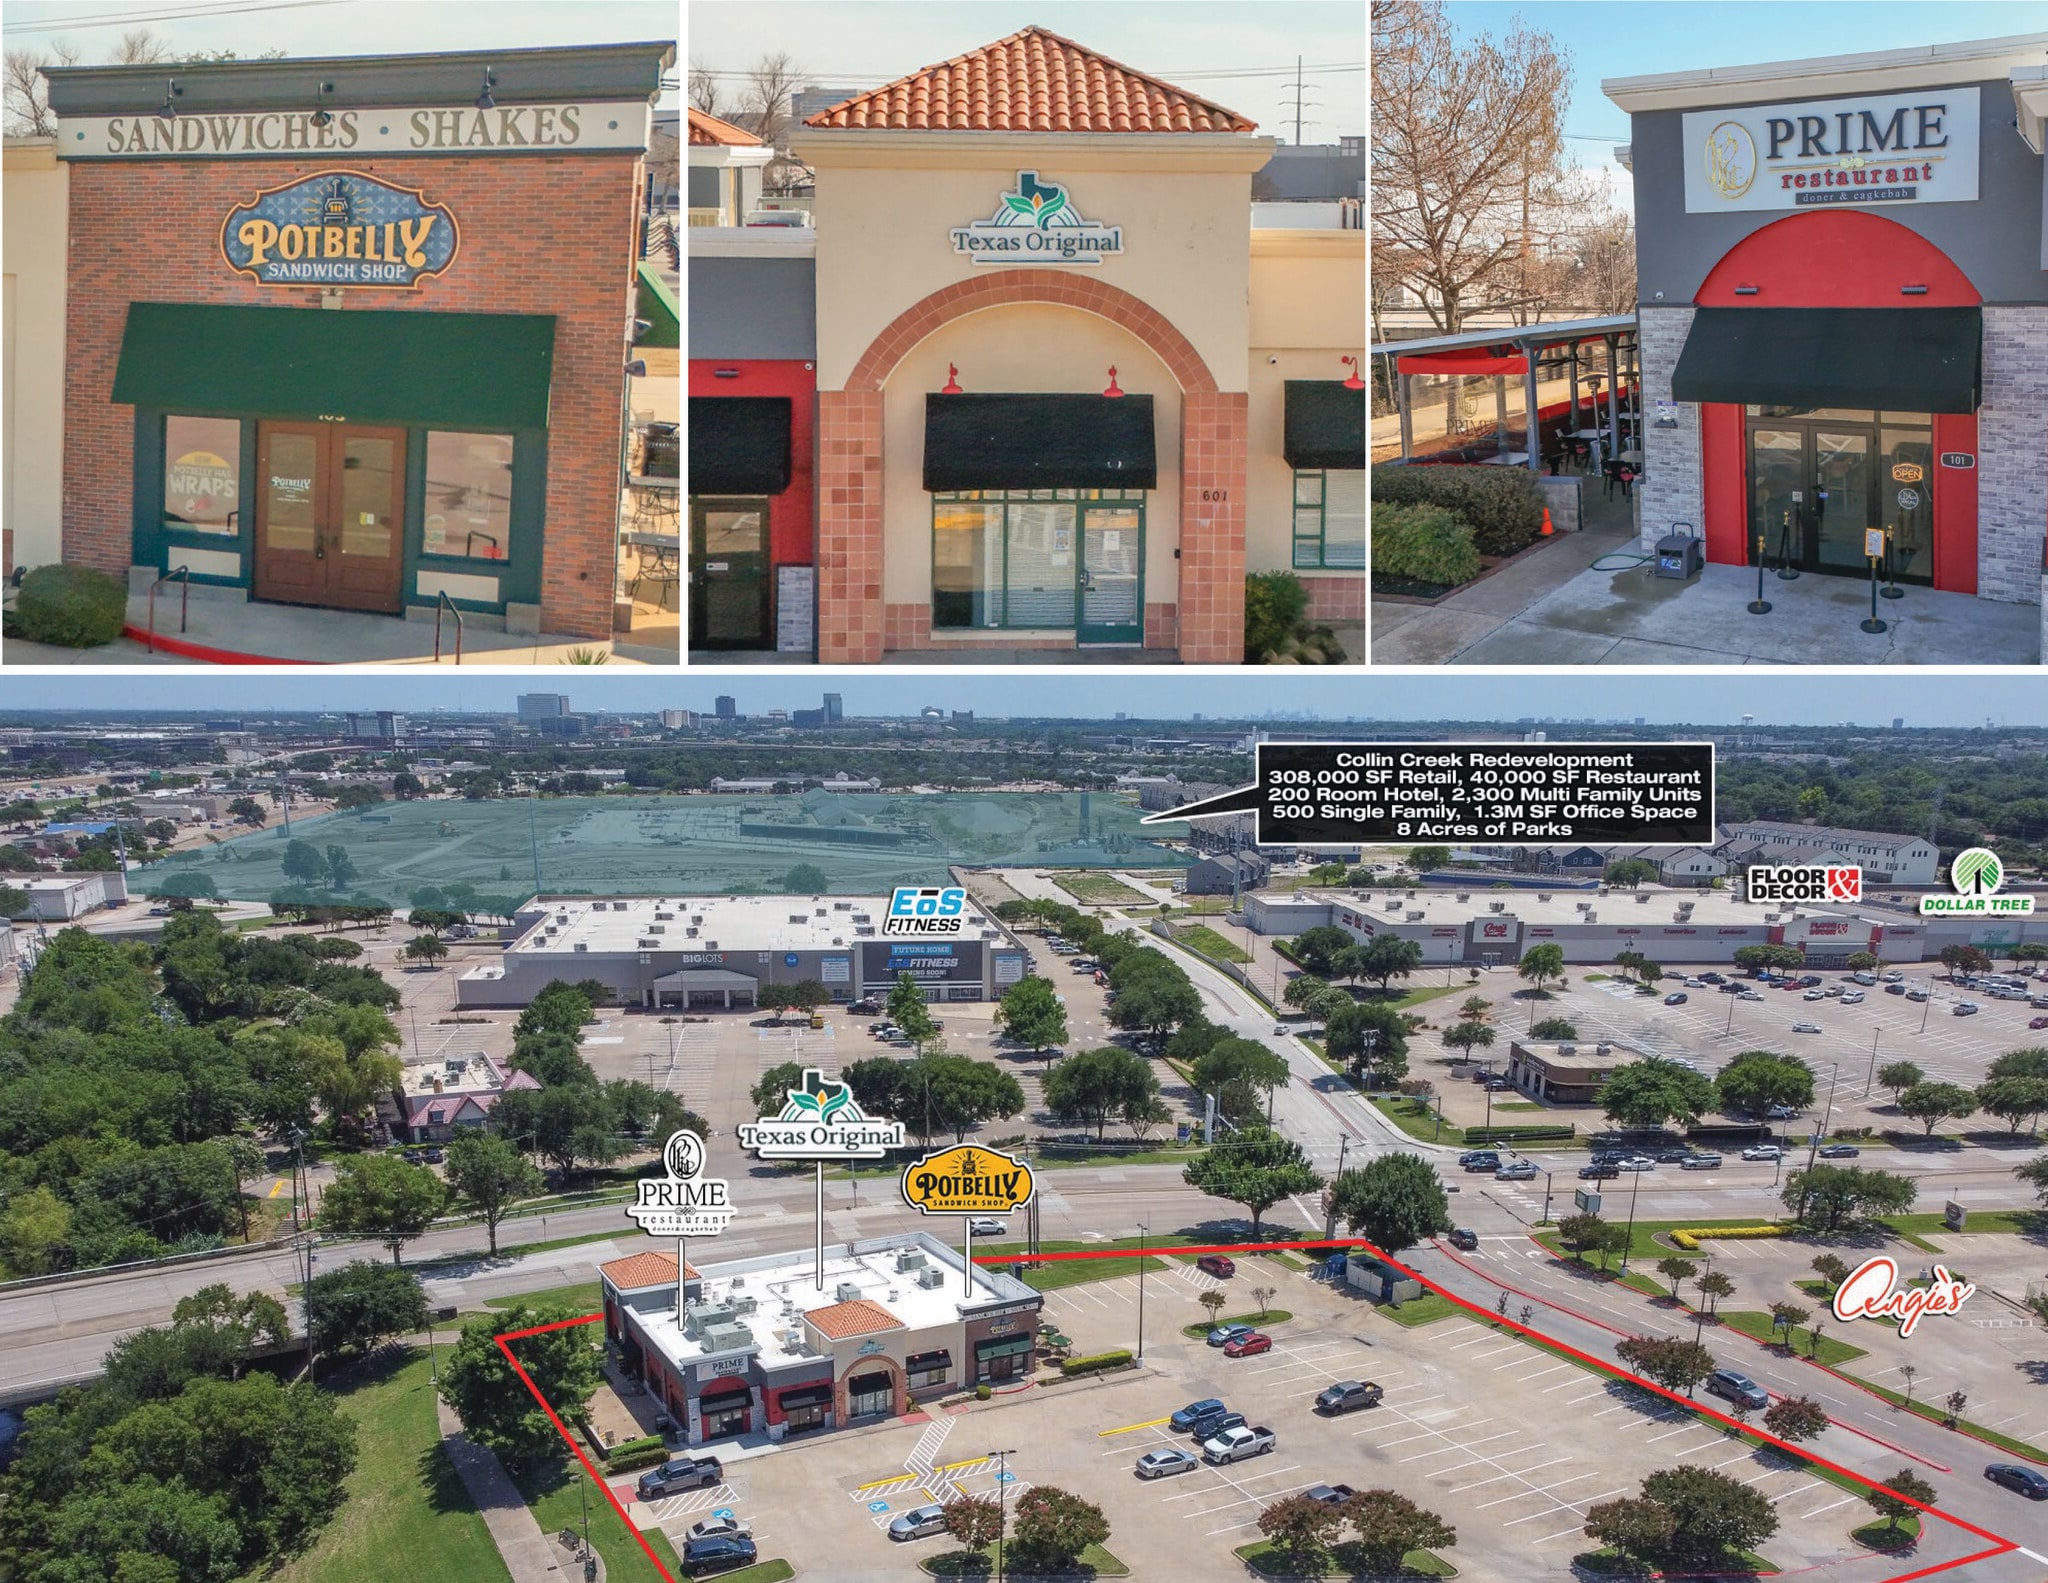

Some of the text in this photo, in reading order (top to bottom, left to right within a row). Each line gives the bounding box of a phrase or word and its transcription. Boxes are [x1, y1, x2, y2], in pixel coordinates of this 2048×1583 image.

[107, 106, 580, 153] SANDWICHES SHAKES
[1765, 104, 1949, 160] PRIME
[1781, 163, 1933, 189] restaurant
[1803, 192, 1834, 203] doner
[1839, 192, 1848, 202] &
[238, 215, 438, 268] POTBELLY
[953, 230, 1120, 258] Texas Original
[268, 262, 407, 280] SANDWICH SHOP
[1950, 455, 1965, 466] 101
[1895, 469, 1921, 479] OPEN
[168, 473, 235, 498] WRAPS
[271, 476, 312, 490] POTBELLY
[1202, 490, 1228, 502] 601
[894, 946, 950, 954] FUTURE HOME
[712, 1357, 744, 1371] PRIME
